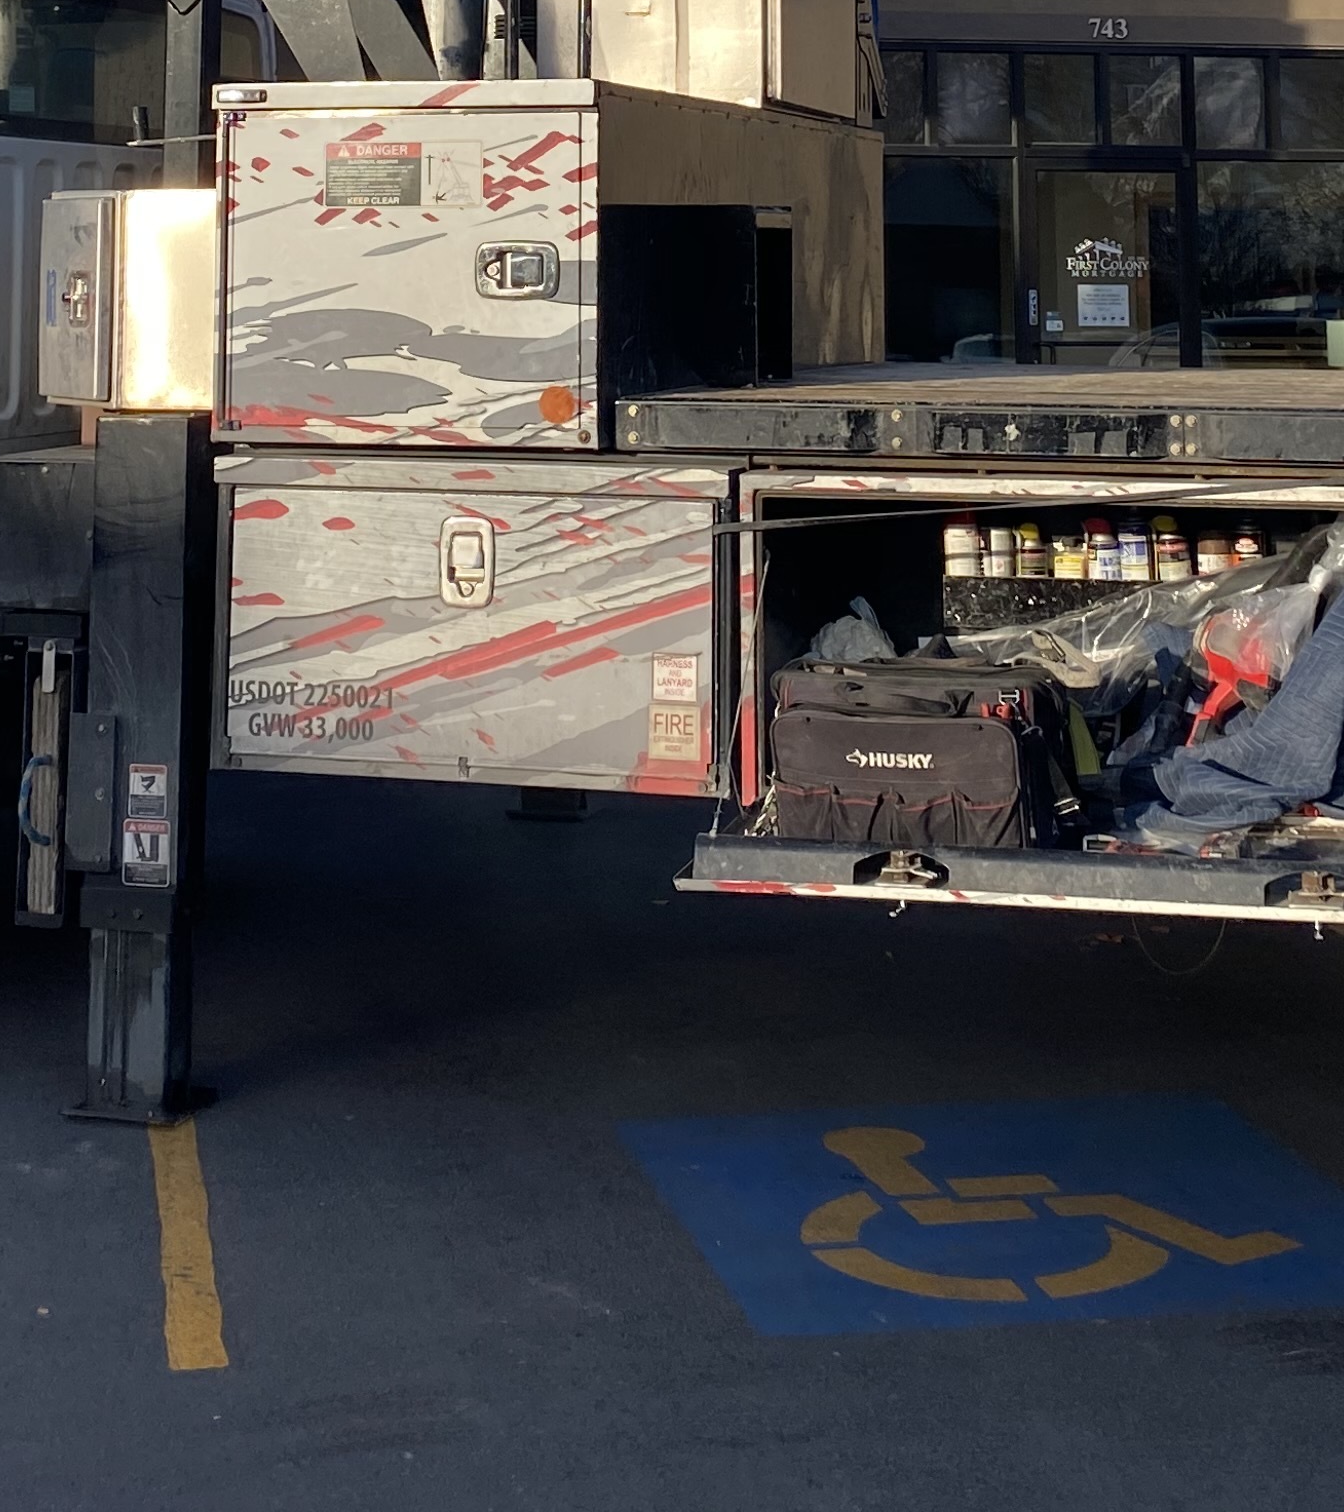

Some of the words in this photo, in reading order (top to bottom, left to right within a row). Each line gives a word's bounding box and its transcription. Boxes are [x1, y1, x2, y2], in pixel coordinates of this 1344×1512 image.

[1088, 18, 1128, 39] 743
[356, 144, 408, 156] DANGER
[347, 196, 370, 205] KEEP
[371, 197, 400, 205] CLEAR
[1066, 256, 1099, 271] FIRST
[1100, 257, 1148, 271] COLONY
[1071, 270, 1144, 278] MORTGAGE
[657, 678, 693, 688] LANYARD
[230, 680, 298, 706] USDOT
[304, 683, 393, 709] 2250021
[249, 712, 297, 738] GVW
[304, 716, 374, 744] 33,000
[654, 713, 694, 736] FIRE
[868, 752, 933, 769] HUSKY
